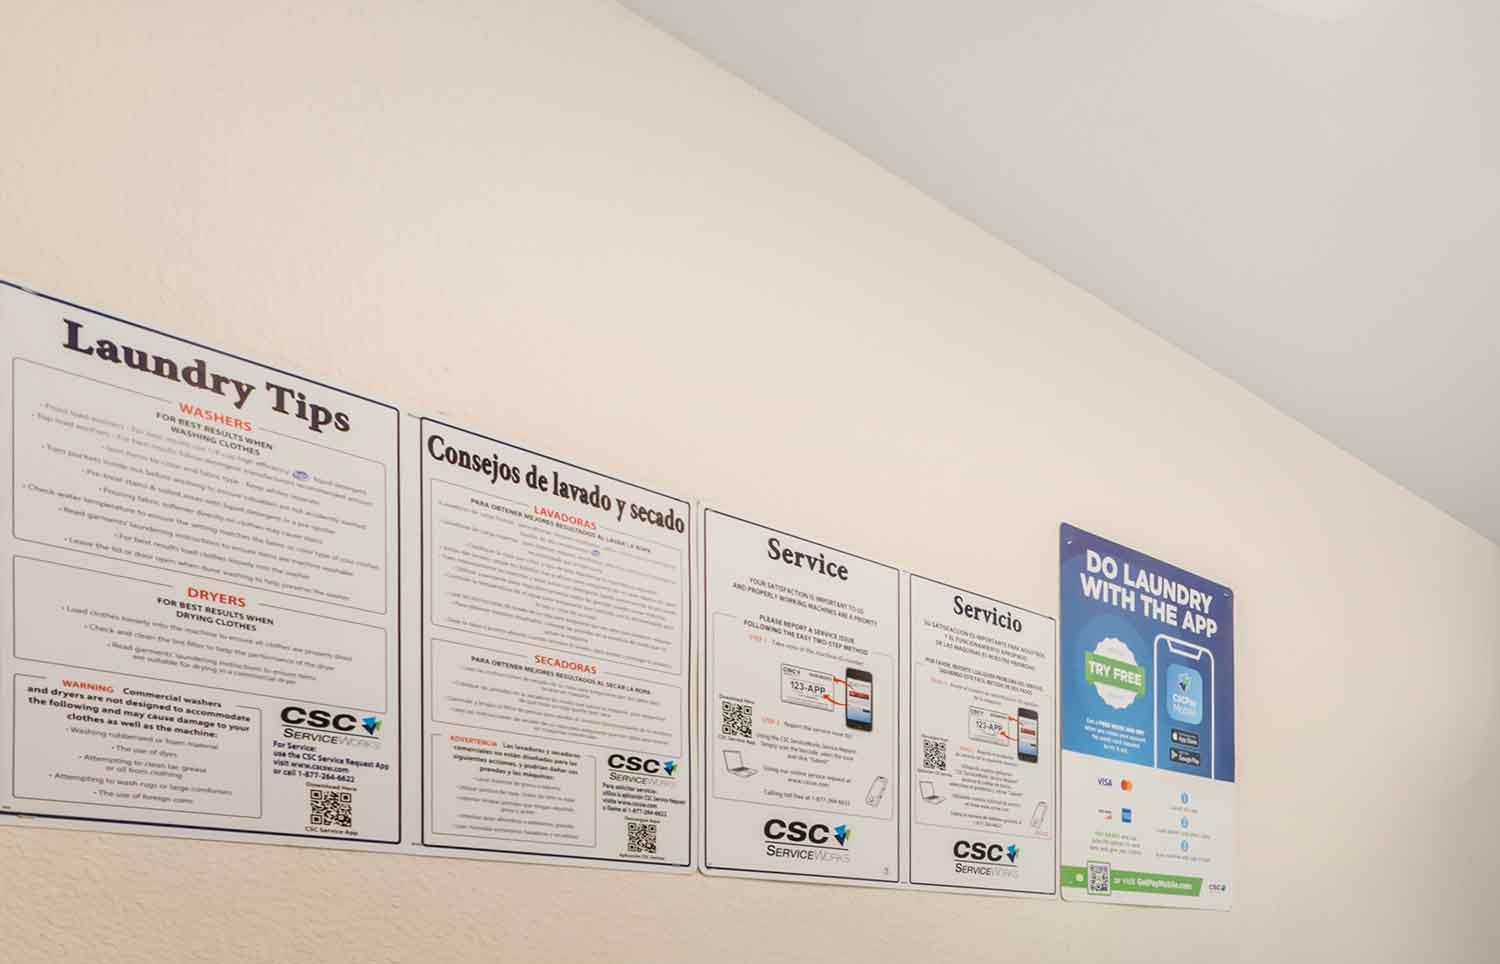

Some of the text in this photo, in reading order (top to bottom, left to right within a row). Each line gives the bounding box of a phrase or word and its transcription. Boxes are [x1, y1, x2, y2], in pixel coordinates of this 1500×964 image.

[63, 318, 351, 433] Laundry Tips
[178, 401, 252, 433] WASHERS
[155, 410, 273, 450] FOR BEST RESULTS WHEN
[169, 424, 260, 456] WASHING CLOTHES
[427, 434, 685, 533] Consejos de lavado y secado
[533, 504, 596, 531] LAVADORAS
[767, 538, 848, 581] Service
[747, 584, 777, 600] PROPERLY
[1086, 549, 1213, 615] DO LAUNDRY
[187, 586, 245, 608] DRYERS
[1080, 572, 1218, 638] WITH THE APP
[156, 596, 274, 625] FOR BEST RESULTS WHEN
[176, 610, 256, 631] DRYING CLOTHES
[953, 595, 1022, 632] Servicio
[744, 619, 782, 634] FOLLOWING
[783, 628, 794, 637] THE
[796, 632, 811, 641] EASY
[759, 614, 782, 625] PLEASE
[783, 620, 806, 631] REPORT
[813, 627, 837, 639] SERVICE
[471, 655, 489, 665] PARA
[534, 655, 597, 675] SECADORAS
[1088, 660, 1142, 686] TRY FREE
[122, 687, 181, 702] Commercial
[183, 696, 221, 708] washers
[791, 680, 825, 695] 123-APP
[27, 685, 48, 695] and
[50, 688, 84, 701] dryers
[105, 696, 123, 705] not
[125, 698, 171, 713] designed
[173, 705, 183, 713] to
[185, 707, 250, 722] accommodate
[28, 696, 249, 733] the following and may cause damage to your
[66, 712, 104, 723] clothes
[120, 719, 140, 728] well
[155, 724, 172, 732] the
[280, 705, 357, 732] CSC
[317, 755, 343, 764] Service
[345, 758, 373, 769] Request
[375, 762, 389, 770] App
[607, 754, 659, 774] CSC
[1097, 777, 1113, 787] VISA
[764, 819, 829, 844] CSC
[953, 840, 1003, 861] CSC
